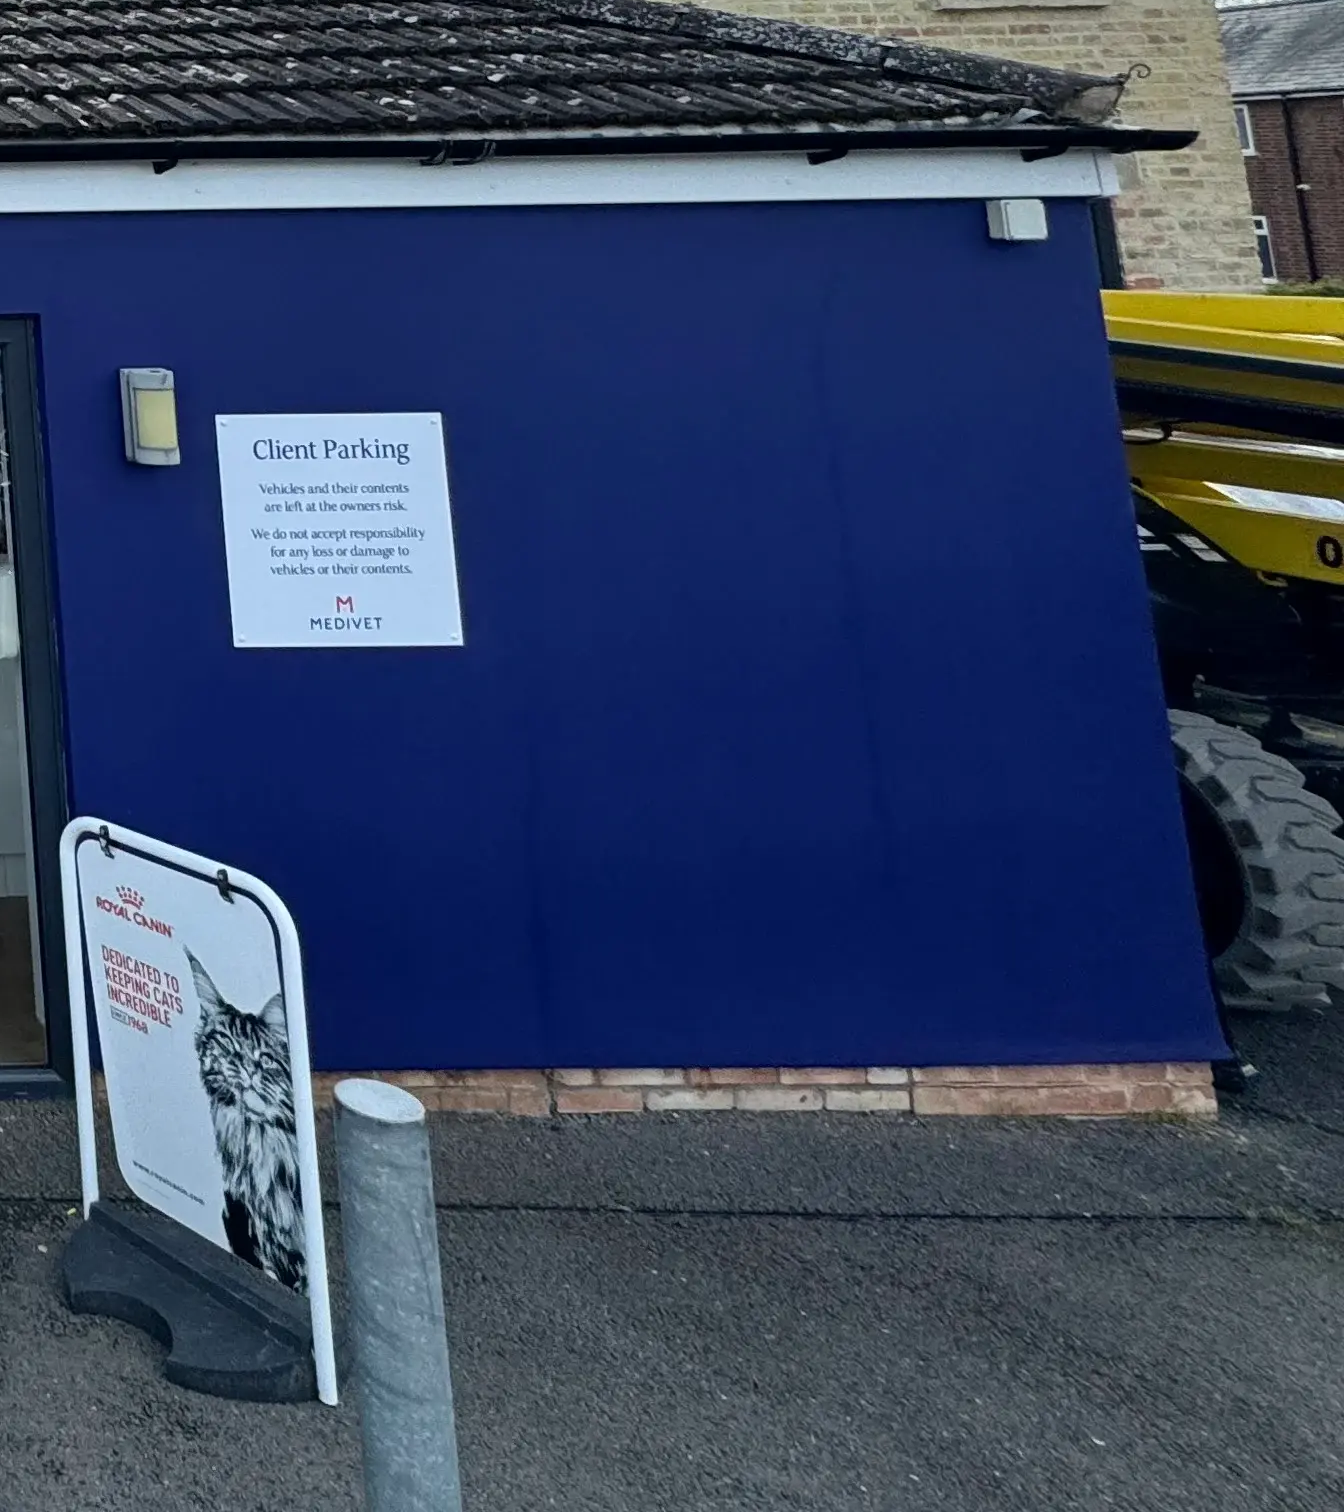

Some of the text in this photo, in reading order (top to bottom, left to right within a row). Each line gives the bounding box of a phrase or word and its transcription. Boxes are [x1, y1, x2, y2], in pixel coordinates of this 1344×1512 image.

[253, 438, 410, 465] Client Parking
[259, 483, 410, 494] Vehicles and their contents
[264, 500, 408, 513] are left at the owners risk.
[251, 527, 425, 542] We do not accept responsibility
[270, 545, 409, 560] for any loss or damage to
[270, 563, 413, 576] vehicles or their contents.
[336, 596, 354, 614] M
[310, 617, 383, 630] MEDIVET
[96, 896, 172, 938] ROYAL CANIN
[101, 944, 180, 993] DEDICATED TO
[104, 963, 183, 1015] KEEPING CATS
[107, 983, 172, 1028] INCREDIBLE
